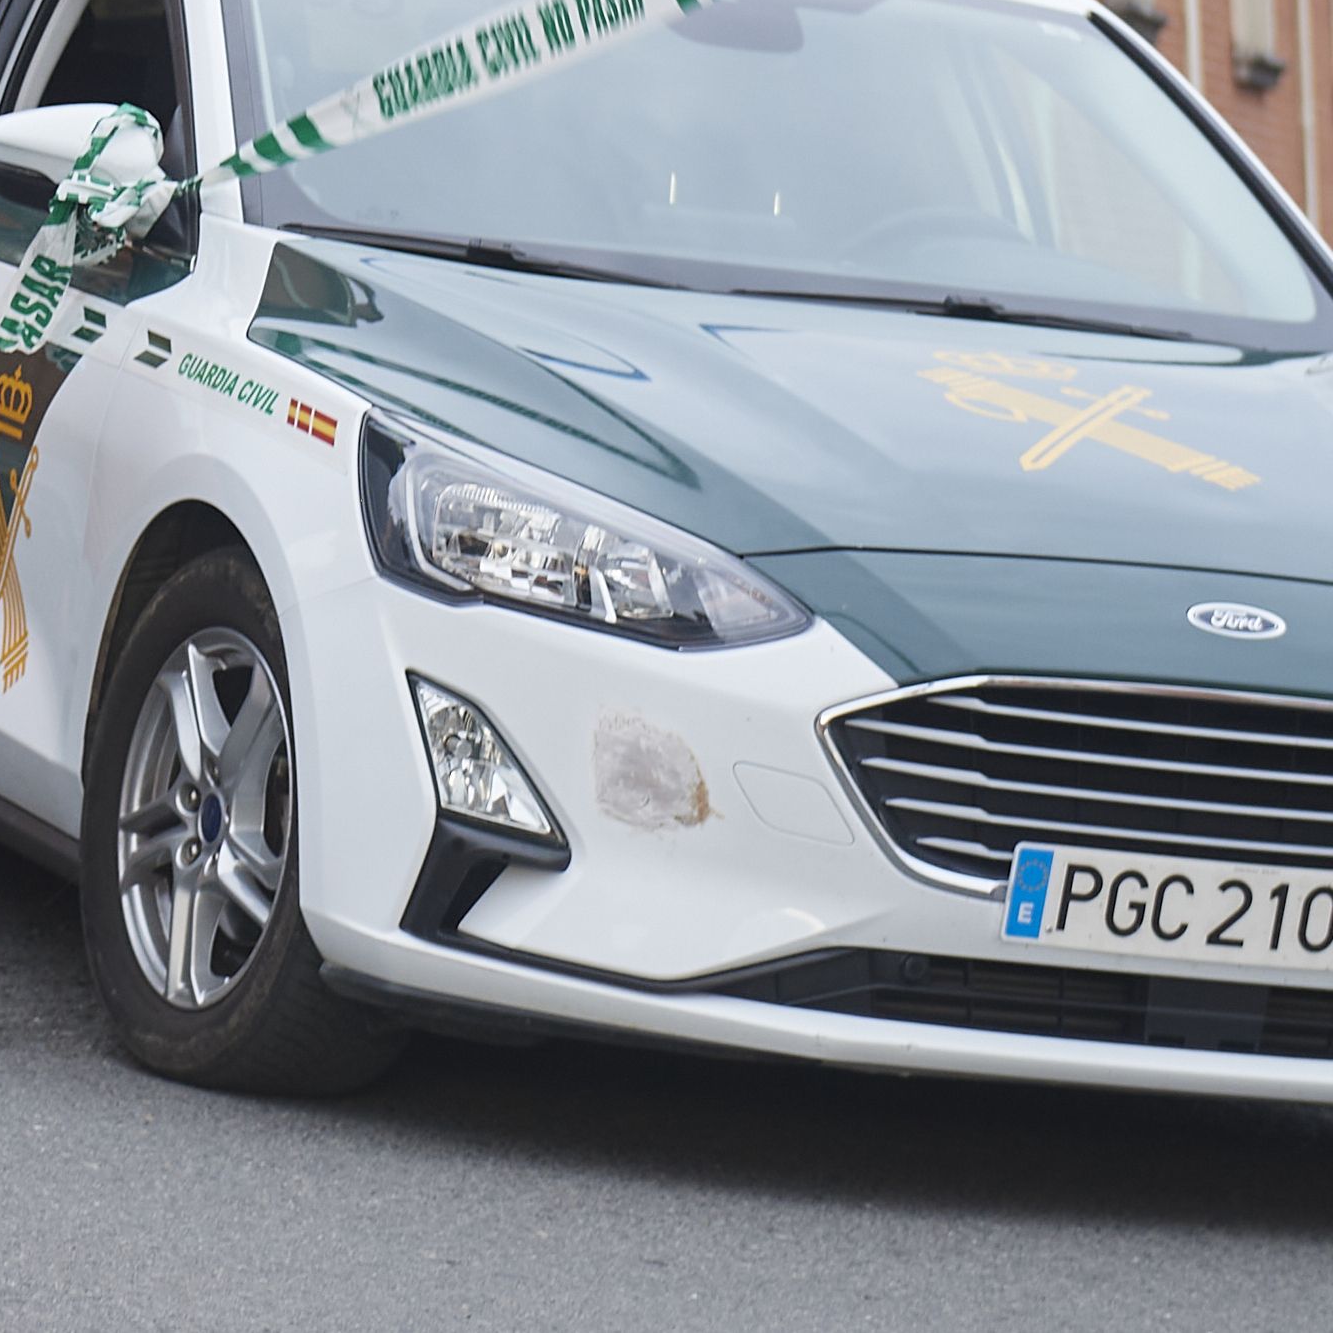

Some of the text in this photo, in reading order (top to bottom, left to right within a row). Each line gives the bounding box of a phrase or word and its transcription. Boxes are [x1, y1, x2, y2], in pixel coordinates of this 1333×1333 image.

[372, 37, 479, 120] GUARDIA
[476, 12, 541, 78] CIVIL
[178, 353, 279, 415] GUARDIA CIVIL
[1210, 609, 1263, 632] Ford
[1017, 901, 1035, 924] E
[1056, 863, 1194, 941] PGC
